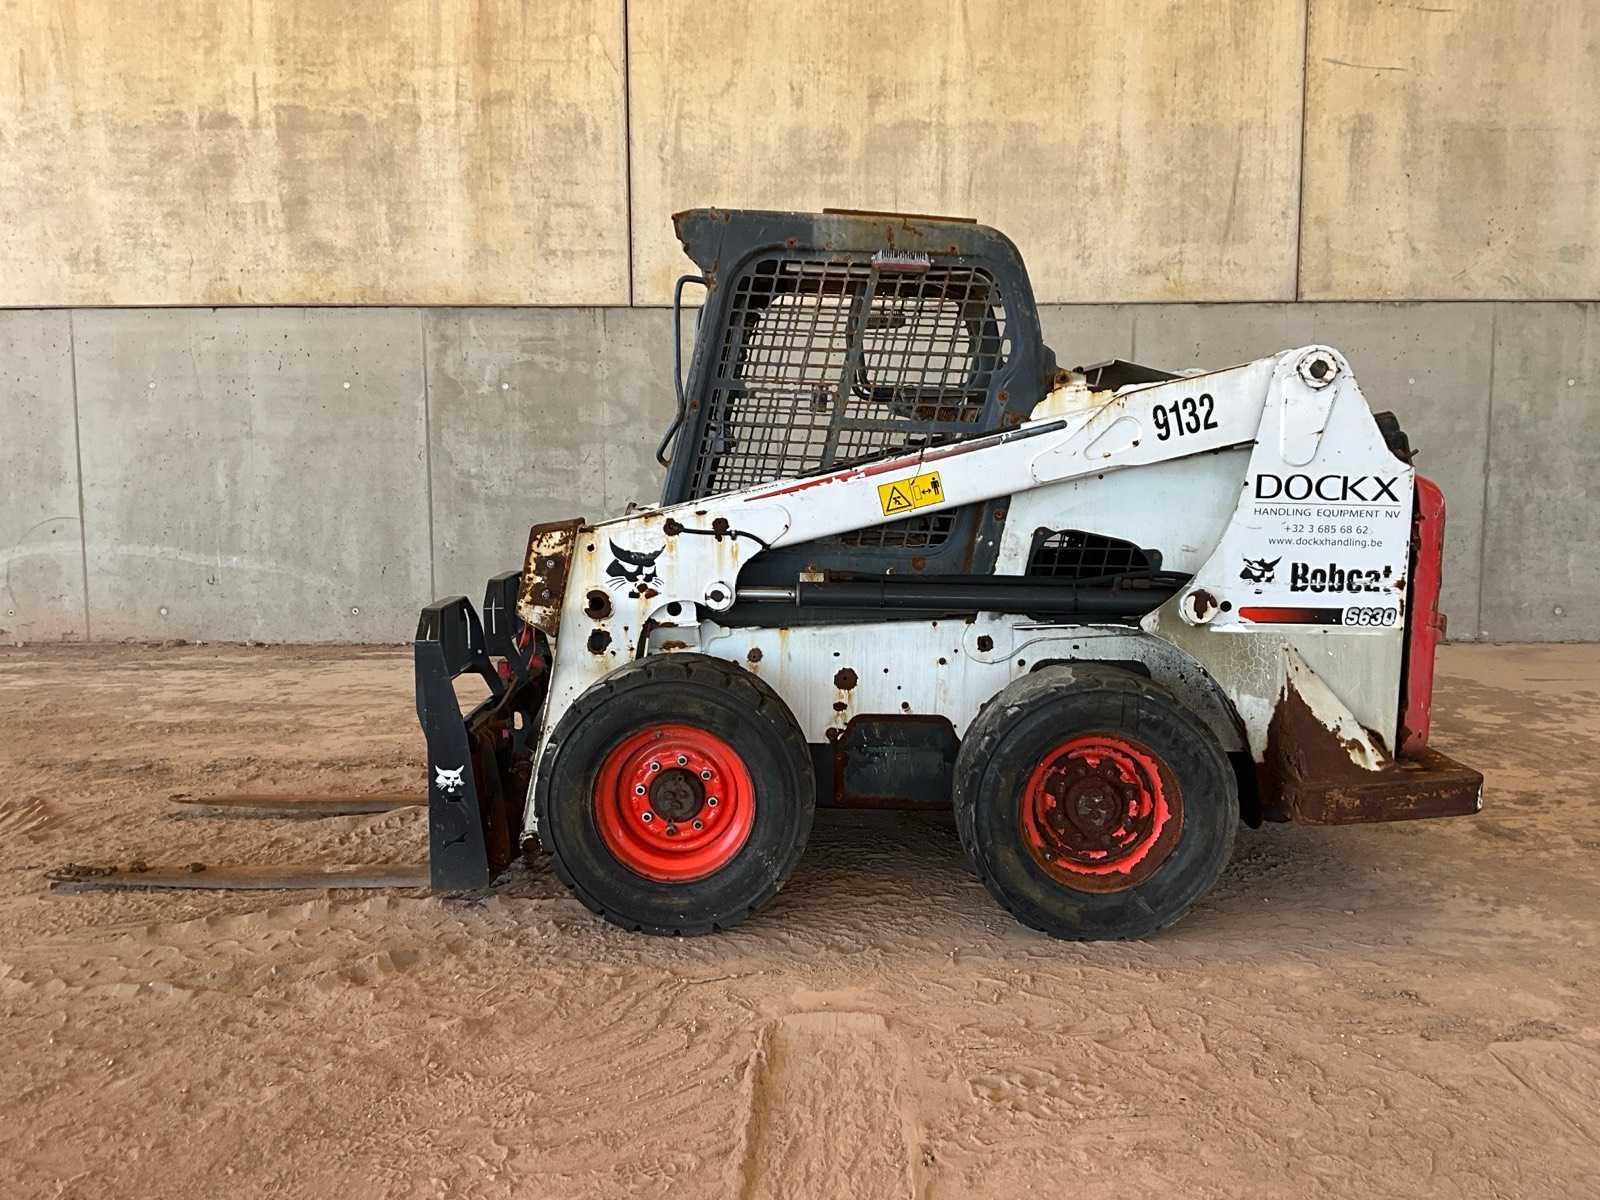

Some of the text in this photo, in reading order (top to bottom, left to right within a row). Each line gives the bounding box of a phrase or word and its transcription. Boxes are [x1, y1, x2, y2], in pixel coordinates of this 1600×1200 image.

[1153, 393, 1218, 441] 9132
[1255, 474, 1400, 502] DOCKX
[1253, 507, 1400, 518] HANDLING EQUIPMENT NV
[1284, 524, 1369, 535] +32 3 685 68 62
[1268, 537, 1383, 548] www.dockxhandling.be
[1290, 562, 1392, 594] Bobcat
[1345, 606, 1397, 626] S630
